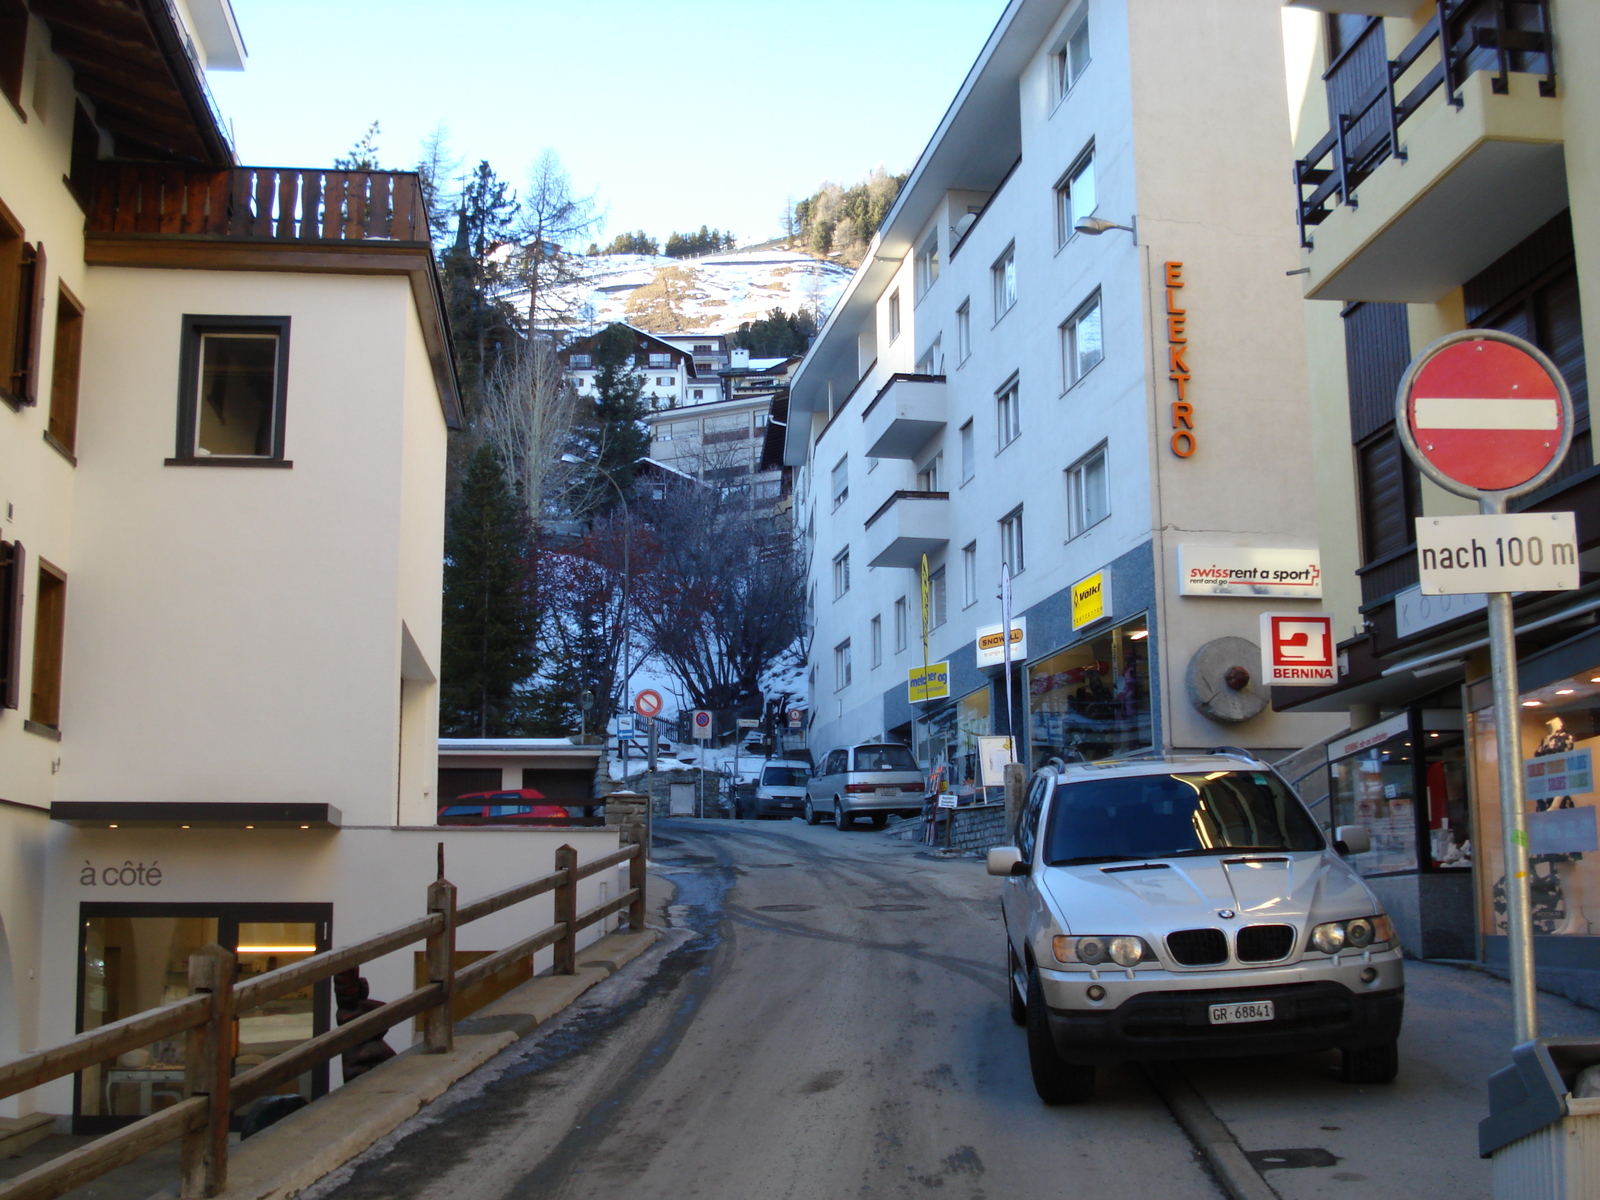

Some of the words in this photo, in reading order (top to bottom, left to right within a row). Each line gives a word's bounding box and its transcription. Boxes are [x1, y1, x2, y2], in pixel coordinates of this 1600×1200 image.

[1164, 261, 1196, 458] ELEKTRO
[1422, 539, 1487, 570] nach
[1495, 536, 1543, 567] 100
[1552, 542, 1575, 565] m
[1260, 569, 1270, 579] a
[1273, 567, 1311, 582] sport
[1079, 582, 1101, 601] Völkl
[982, 632, 1020, 647] SNOWLL
[1273, 668, 1334, 679] BERNINA
[80, 860, 97, 886] à
[102, 860, 162, 886] côté
[1213, 1008, 1227, 1020] GR
[1234, 1004, 1270, 1019] 68841
